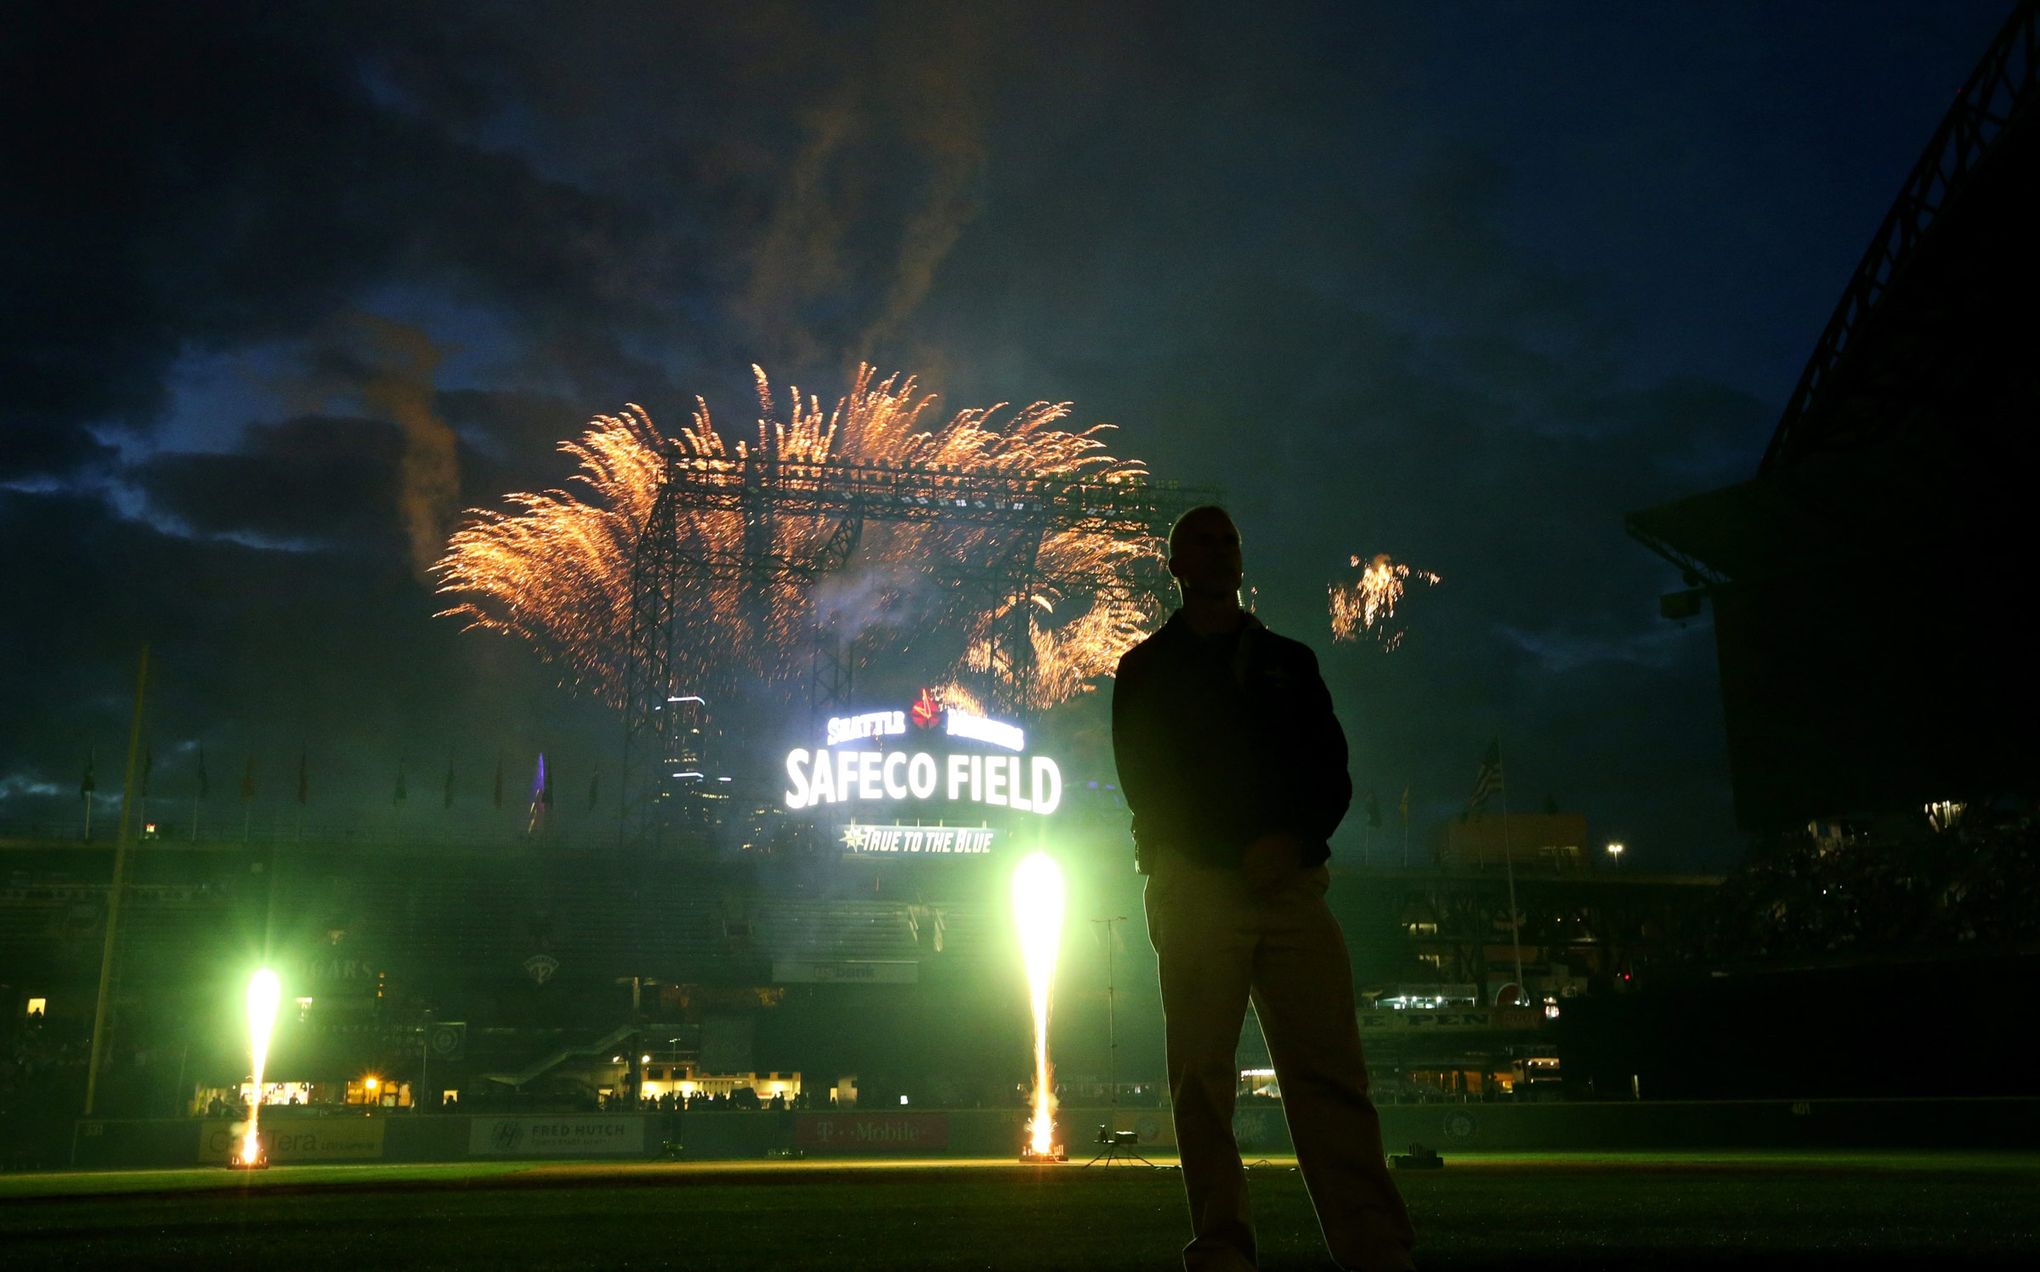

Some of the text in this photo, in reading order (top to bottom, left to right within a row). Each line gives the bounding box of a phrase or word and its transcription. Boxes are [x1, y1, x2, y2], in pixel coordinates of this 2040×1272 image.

[785, 748, 1062, 815] SAFECO FIELD
[863, 828, 993, 853] TRUE TO THE BLUE
[532, 1124, 625, 1137] FRED HUTCH
